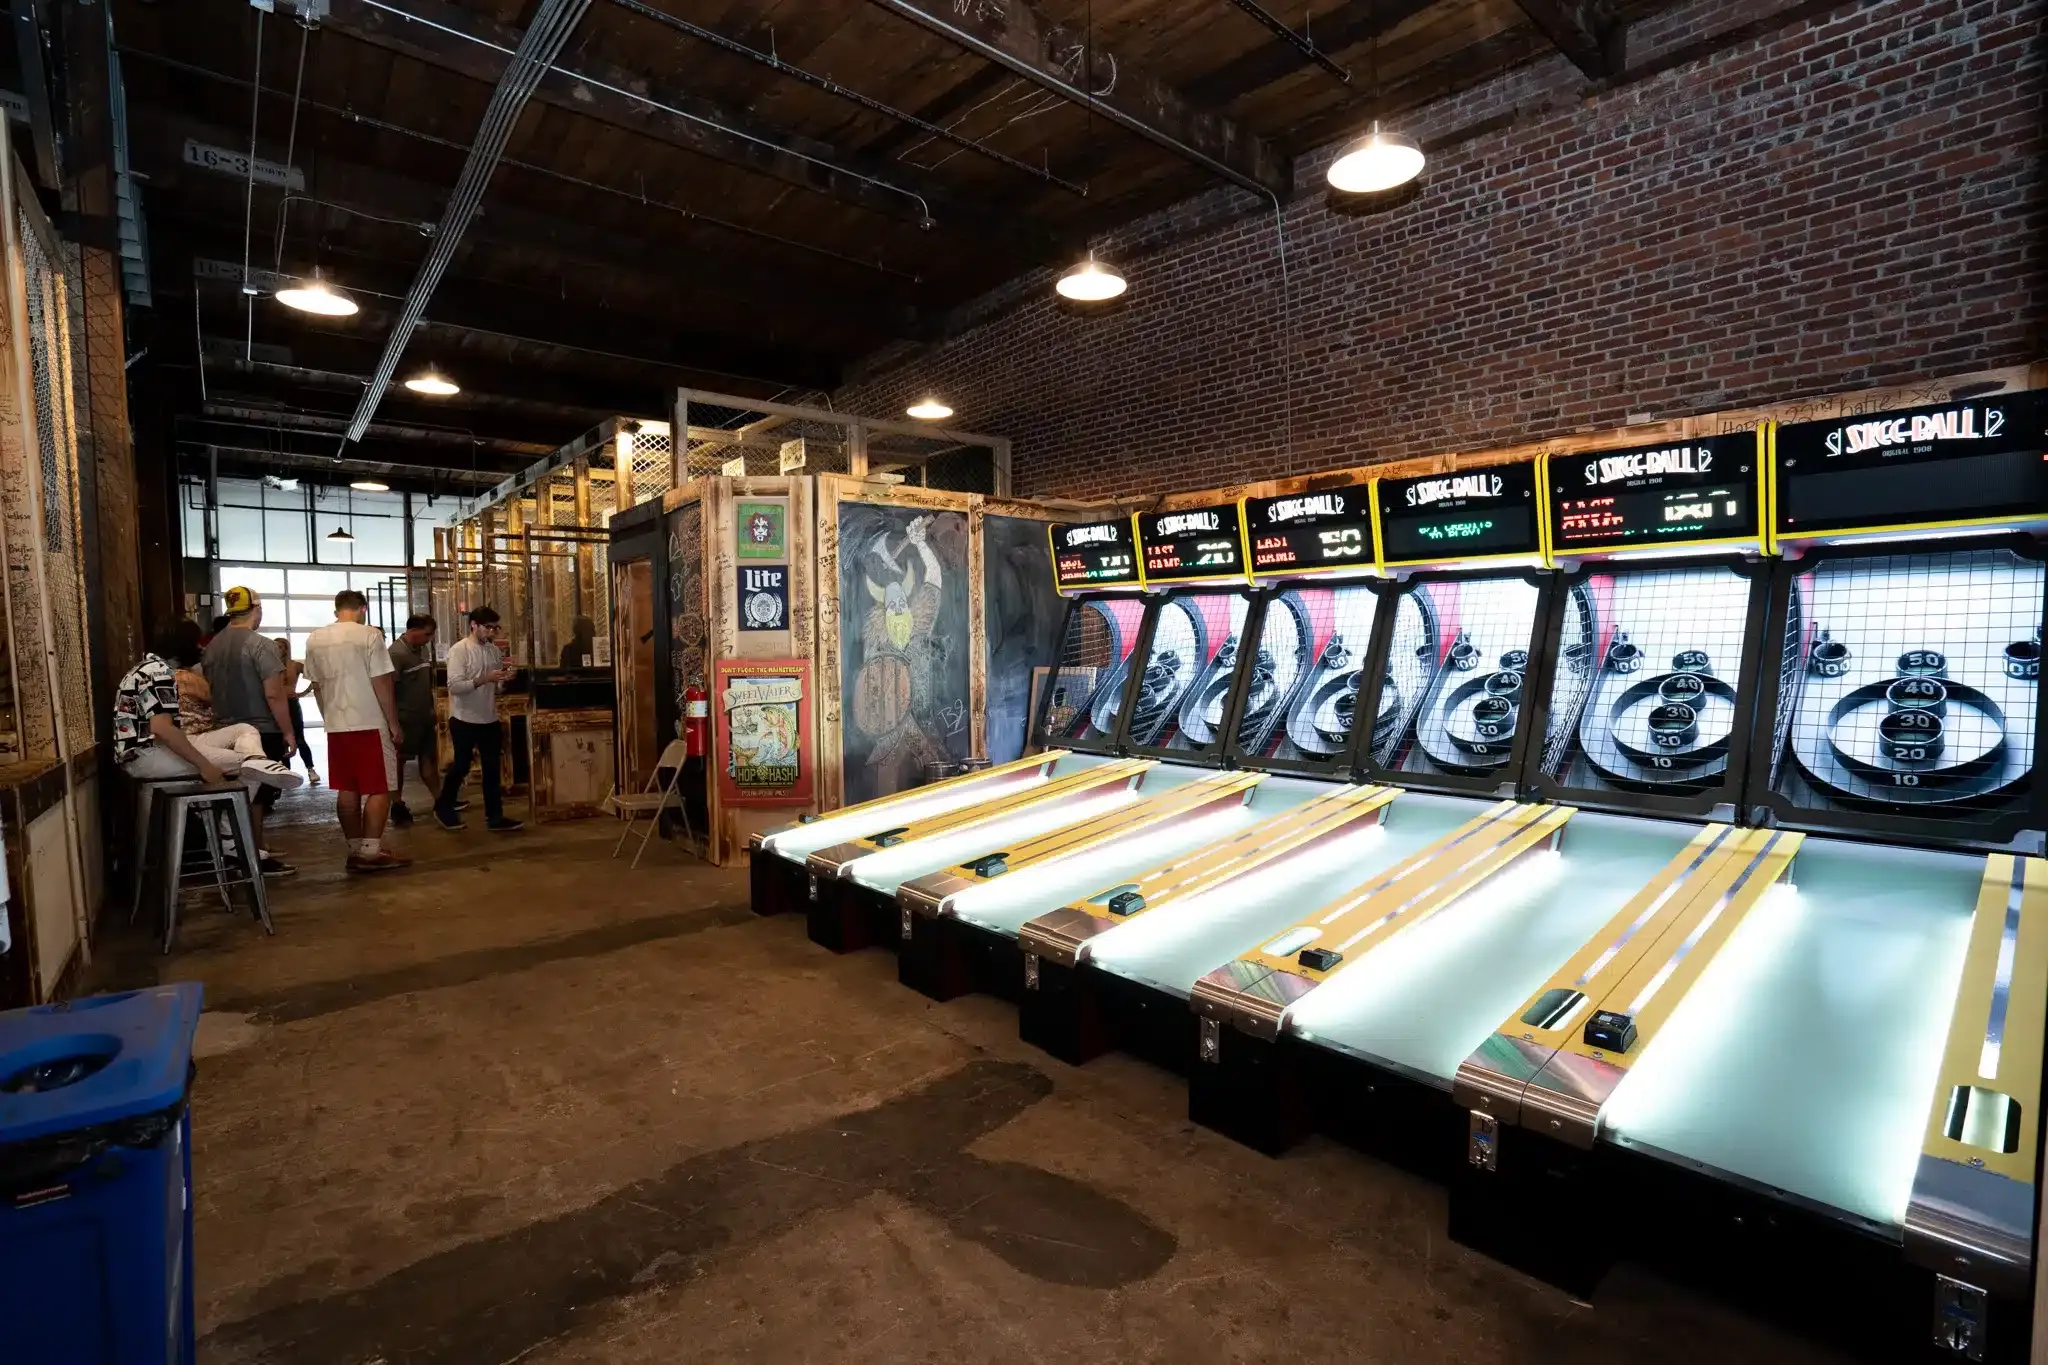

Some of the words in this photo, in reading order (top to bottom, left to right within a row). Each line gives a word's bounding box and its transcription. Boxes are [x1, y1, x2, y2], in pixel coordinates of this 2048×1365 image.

[1846, 407, 1983, 454] SKEE-BALL
[1912, 445, 1933, 454] 1908
[1600, 448, 1697, 483] SKEE-BALL
[1417, 475, 1493, 505] SKEE-BALL
[1276, 495, 1337, 521] SKEE-BALL
[1164, 512, 1213, 535] SKEE-BALL
[744, 569, 782, 592] Lite
[1683, 652, 1706, 664] 50
[1909, 655, 1939, 666] 50
[1613, 657, 1641, 672] 100
[1817, 661, 1850, 676] 100
[1500, 673, 1519, 685] 40
[1676, 678, 1699, 690] 40
[1904, 681, 1935, 695] 40
[1488, 700, 1508, 710] 30
[1666, 707, 1690, 718] 30
[1900, 715, 1930, 728] 30
[1478, 725, 1498, 735] 20
[1329, 733, 1344, 743] 10
[1656, 735, 1681, 746] 20
[1470, 744, 1488, 753] 10
[1894, 748, 1926, 760] 20
[1652, 756, 1672, 768] 10
[738, 768, 756, 782] HOP
[769, 767, 794, 782] HASH
[1892, 773, 1919, 786] 10
